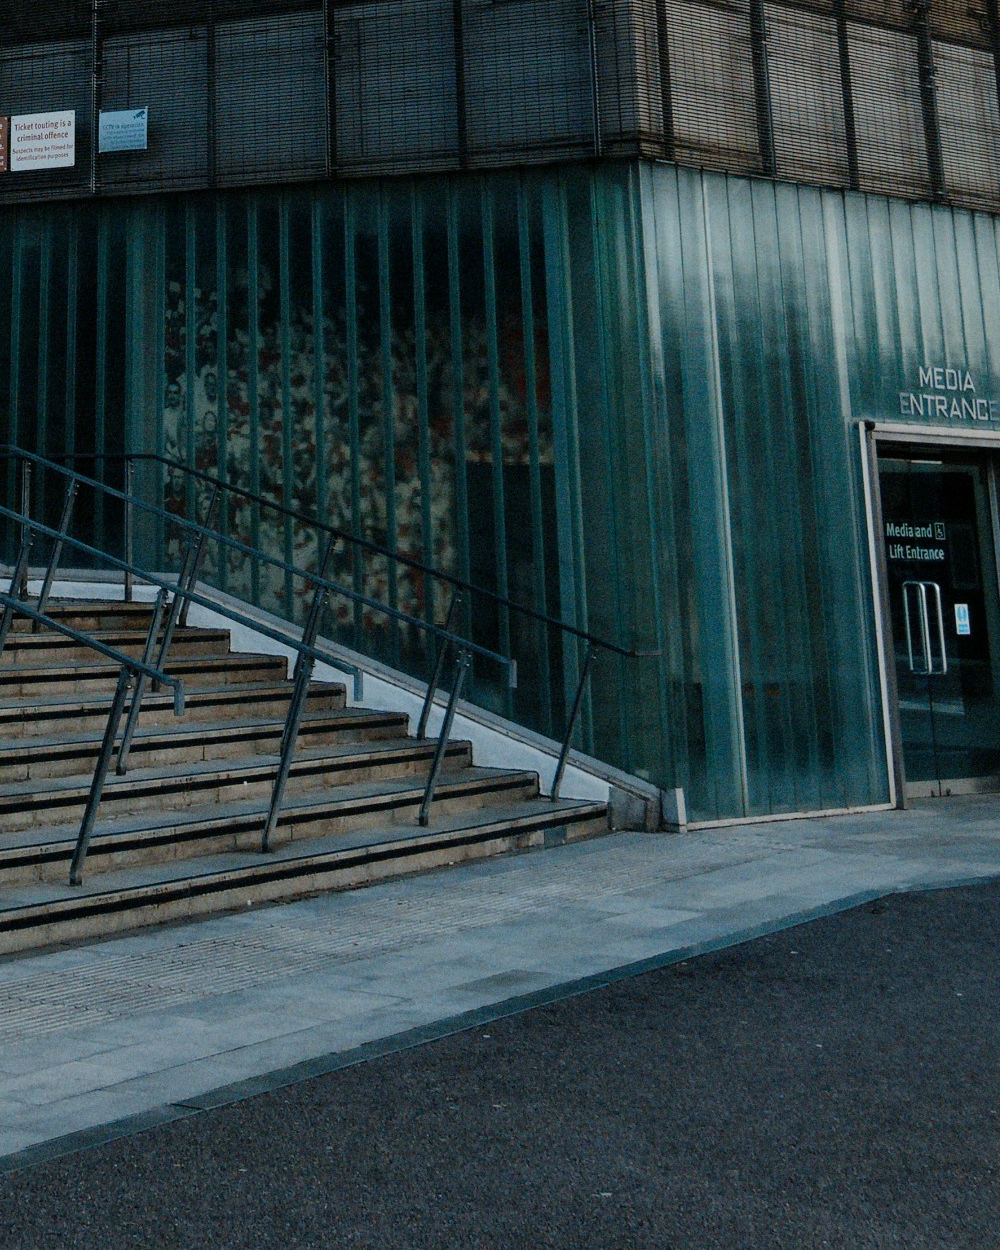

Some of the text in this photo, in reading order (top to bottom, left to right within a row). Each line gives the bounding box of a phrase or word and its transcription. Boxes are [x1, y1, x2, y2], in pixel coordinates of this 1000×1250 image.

[14, 123, 33, 131] Ticket
[34, 121, 59, 129] touting
[17, 132, 69, 142] criminal offence
[12, 147, 33, 155] Suspects
[16, 152, 69, 162] identification purposes
[919, 366, 976, 392] MEDIA
[900, 392, 1000, 421] ENTRANCE
[886, 522, 932, 538] Media and
[889, 544, 945, 560] Lift Entrance
